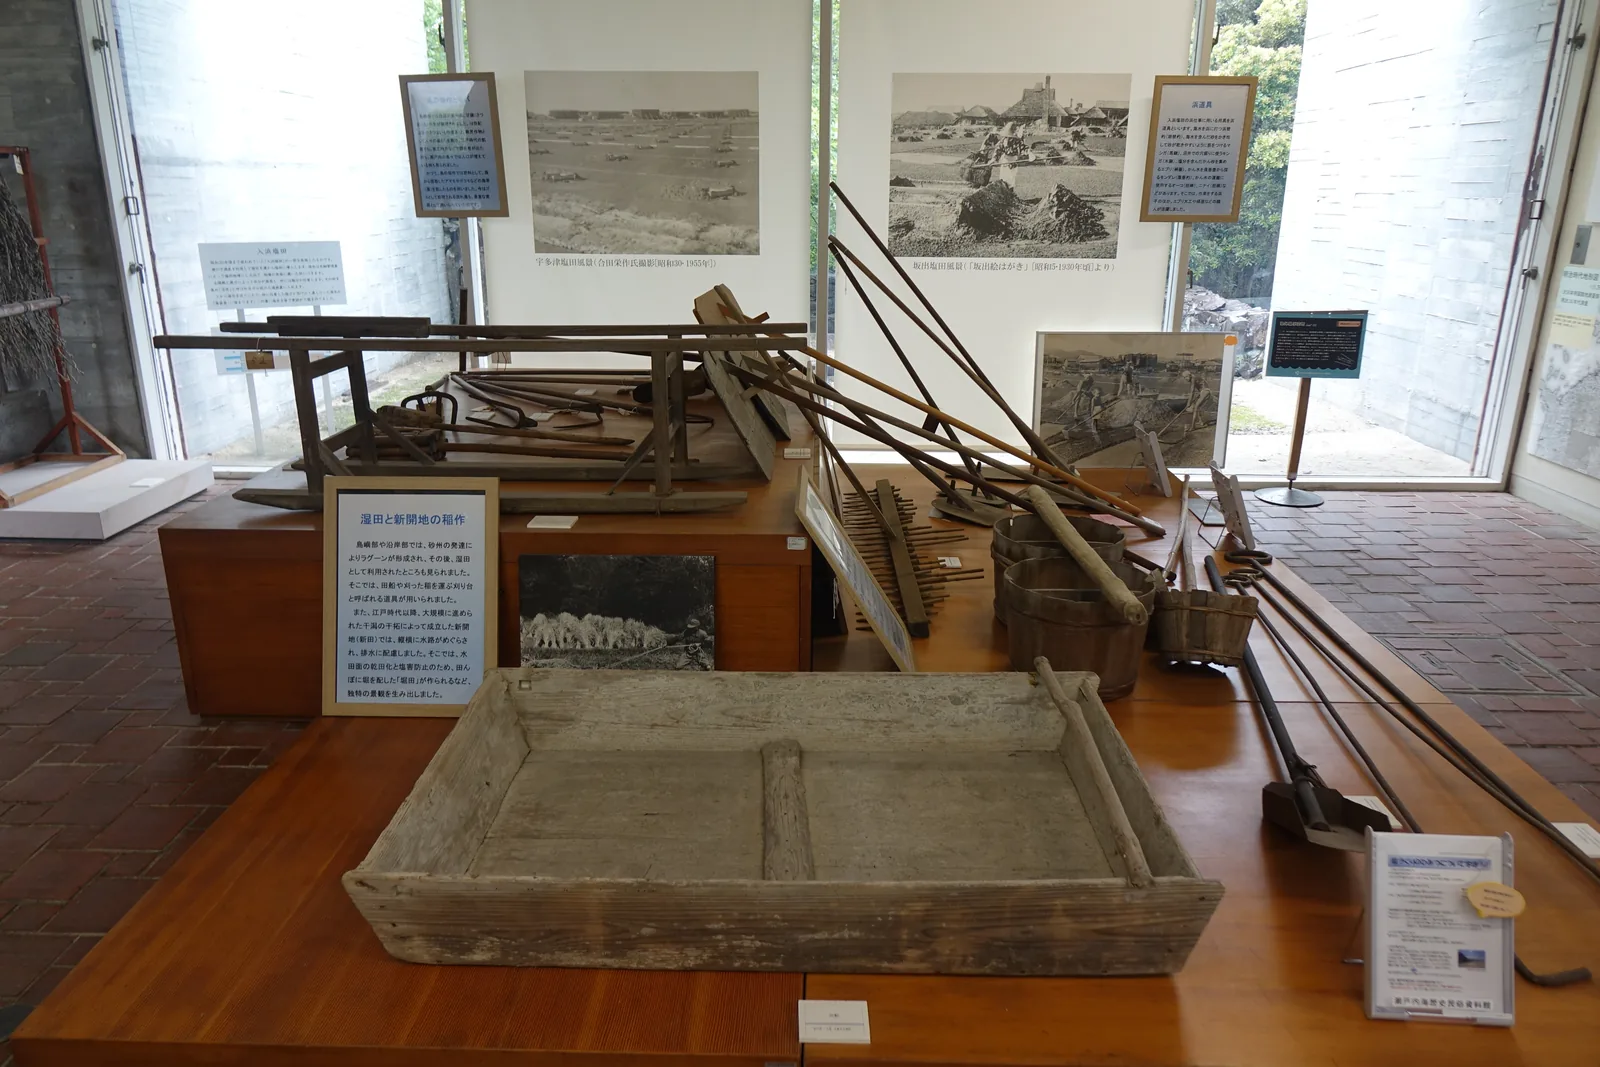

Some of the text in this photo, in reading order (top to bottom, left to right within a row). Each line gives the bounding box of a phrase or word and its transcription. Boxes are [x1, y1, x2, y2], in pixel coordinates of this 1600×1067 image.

[1191, 101, 1213, 109] 浜道具
[360, 513, 466, 526] 湿田と新開地の稲作
[356, 540, 473, 549] 島嶼部や沿岸部では、砂州の発達に
[348, 554, 471, 563] よりラグーンが形成され、その後、湿田
[348, 568, 471, 577] として利用されたところも見られました。
[348, 582, 473, 590] そこでは、田船や刈った稲を運ぶ刈り台
[348, 595, 457, 604] と呼ばれる道具が用いられました。
[353, 609, 473, 617] また、江戸時代以降、大規模に進めら
[348, 622, 470, 631] れた干潟の干拓によって成立した新開
[348, 636, 468, 644] 地（新田）では、縦横に水路がめぐらさ
[348, 649, 468, 658] れ、排水に配慮しました。そこでは、水
[347, 663, 471, 671] 田面の乾田化と塩害防止のため、田ん
[347, 676, 472, 685] ぼに堀を配した「堀田」が作られるなど、
[347, 690, 443, 698] 独特の景観を生み出しました。
